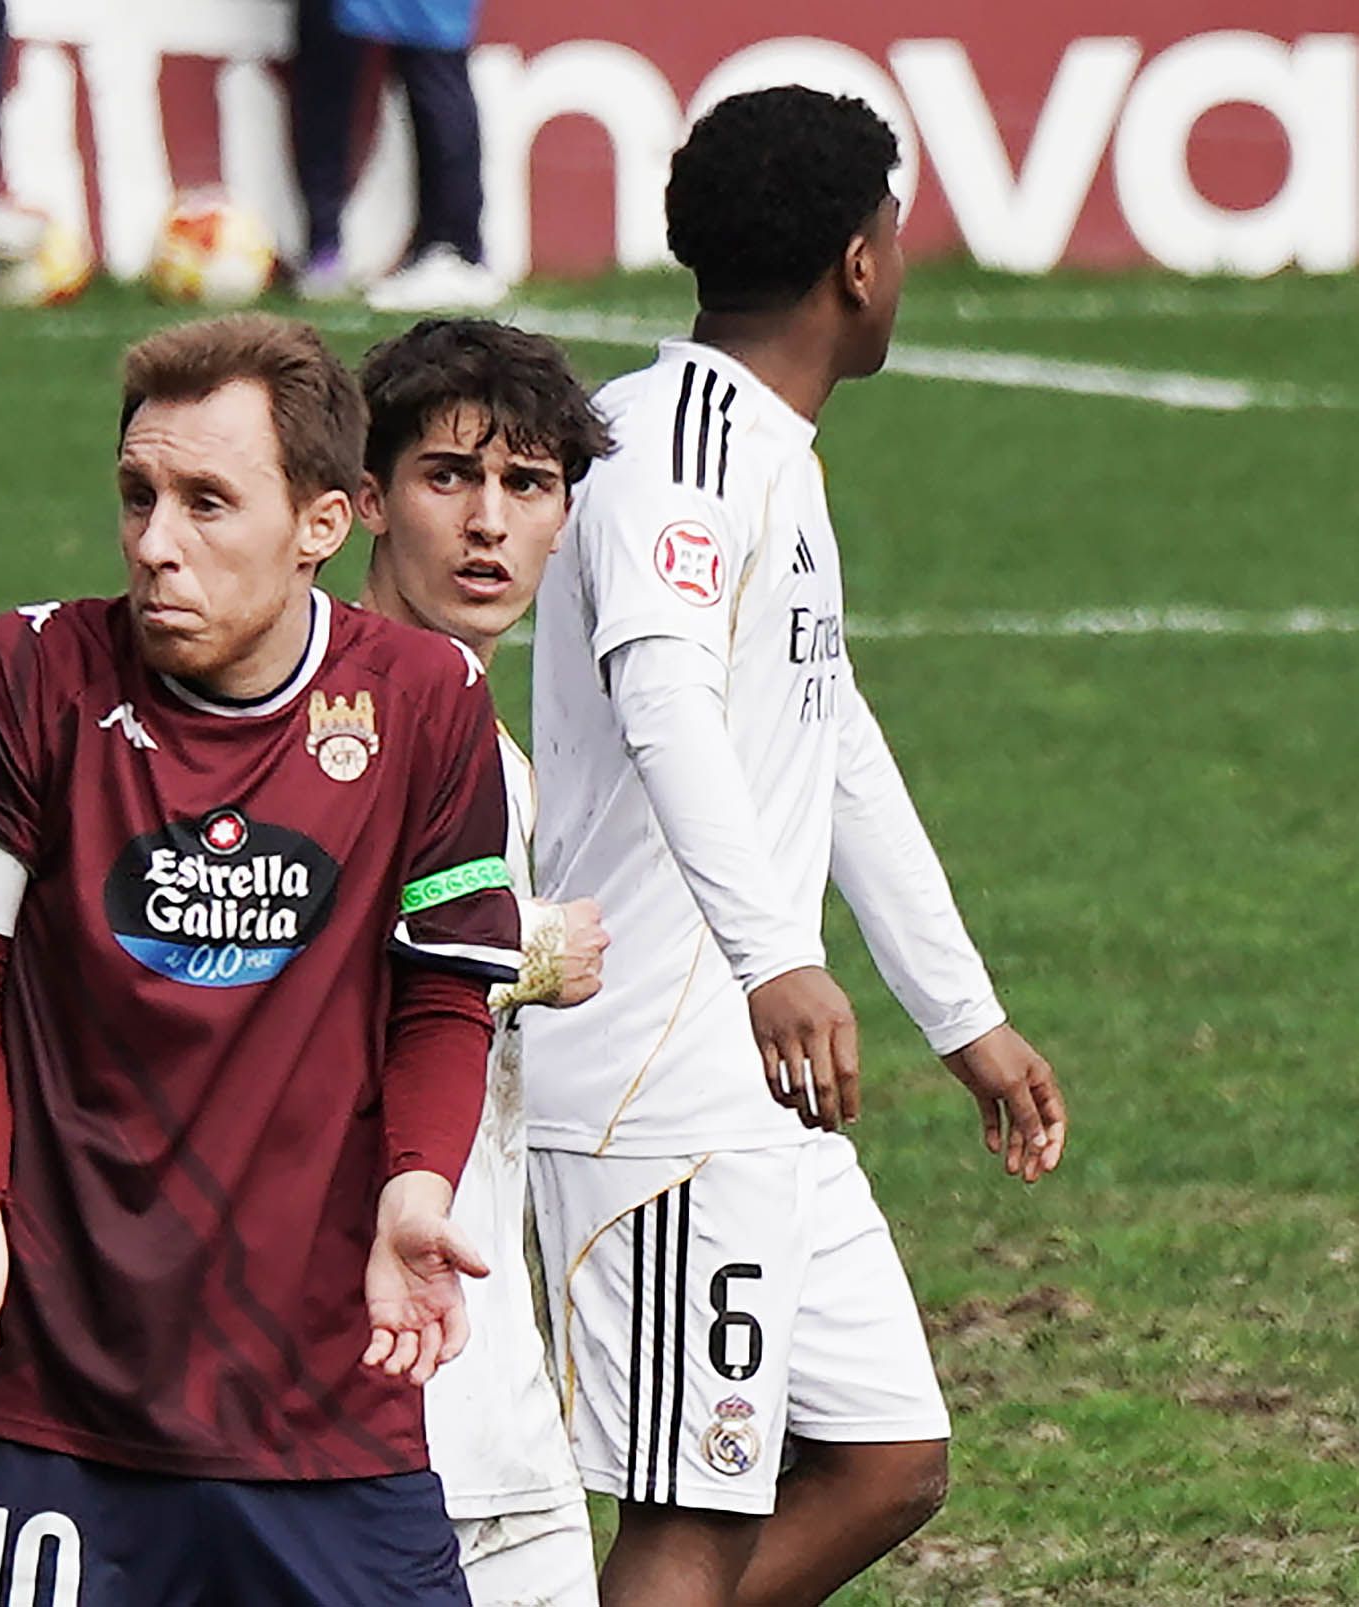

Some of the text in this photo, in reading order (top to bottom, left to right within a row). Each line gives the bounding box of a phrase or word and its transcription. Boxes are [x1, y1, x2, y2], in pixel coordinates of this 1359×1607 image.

[145, 848, 310, 898] Estrella
[146, 886, 299, 941] Galicia
[708, 1262, 764, 1381] 6
